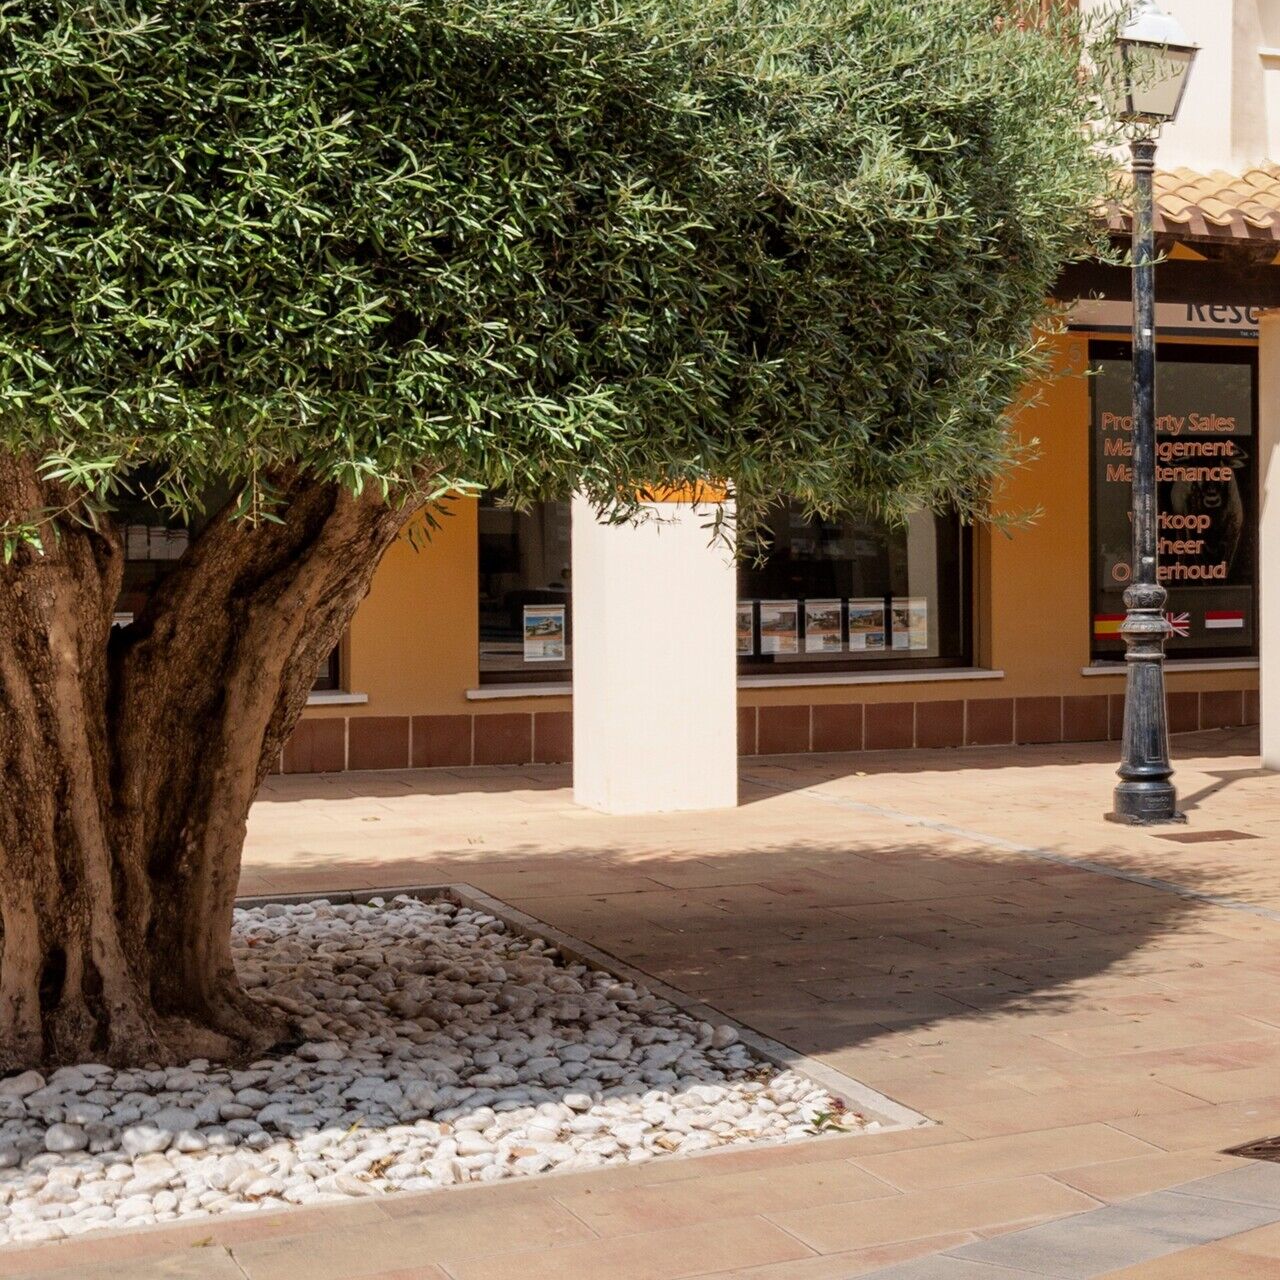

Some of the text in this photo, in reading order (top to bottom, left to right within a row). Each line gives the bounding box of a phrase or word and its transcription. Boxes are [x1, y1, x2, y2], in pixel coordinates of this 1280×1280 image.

[1188, 413, 1235, 432] Sales
[1106, 464, 1232, 482] Matenance
[1112, 561, 1227, 581] Oerhoud
